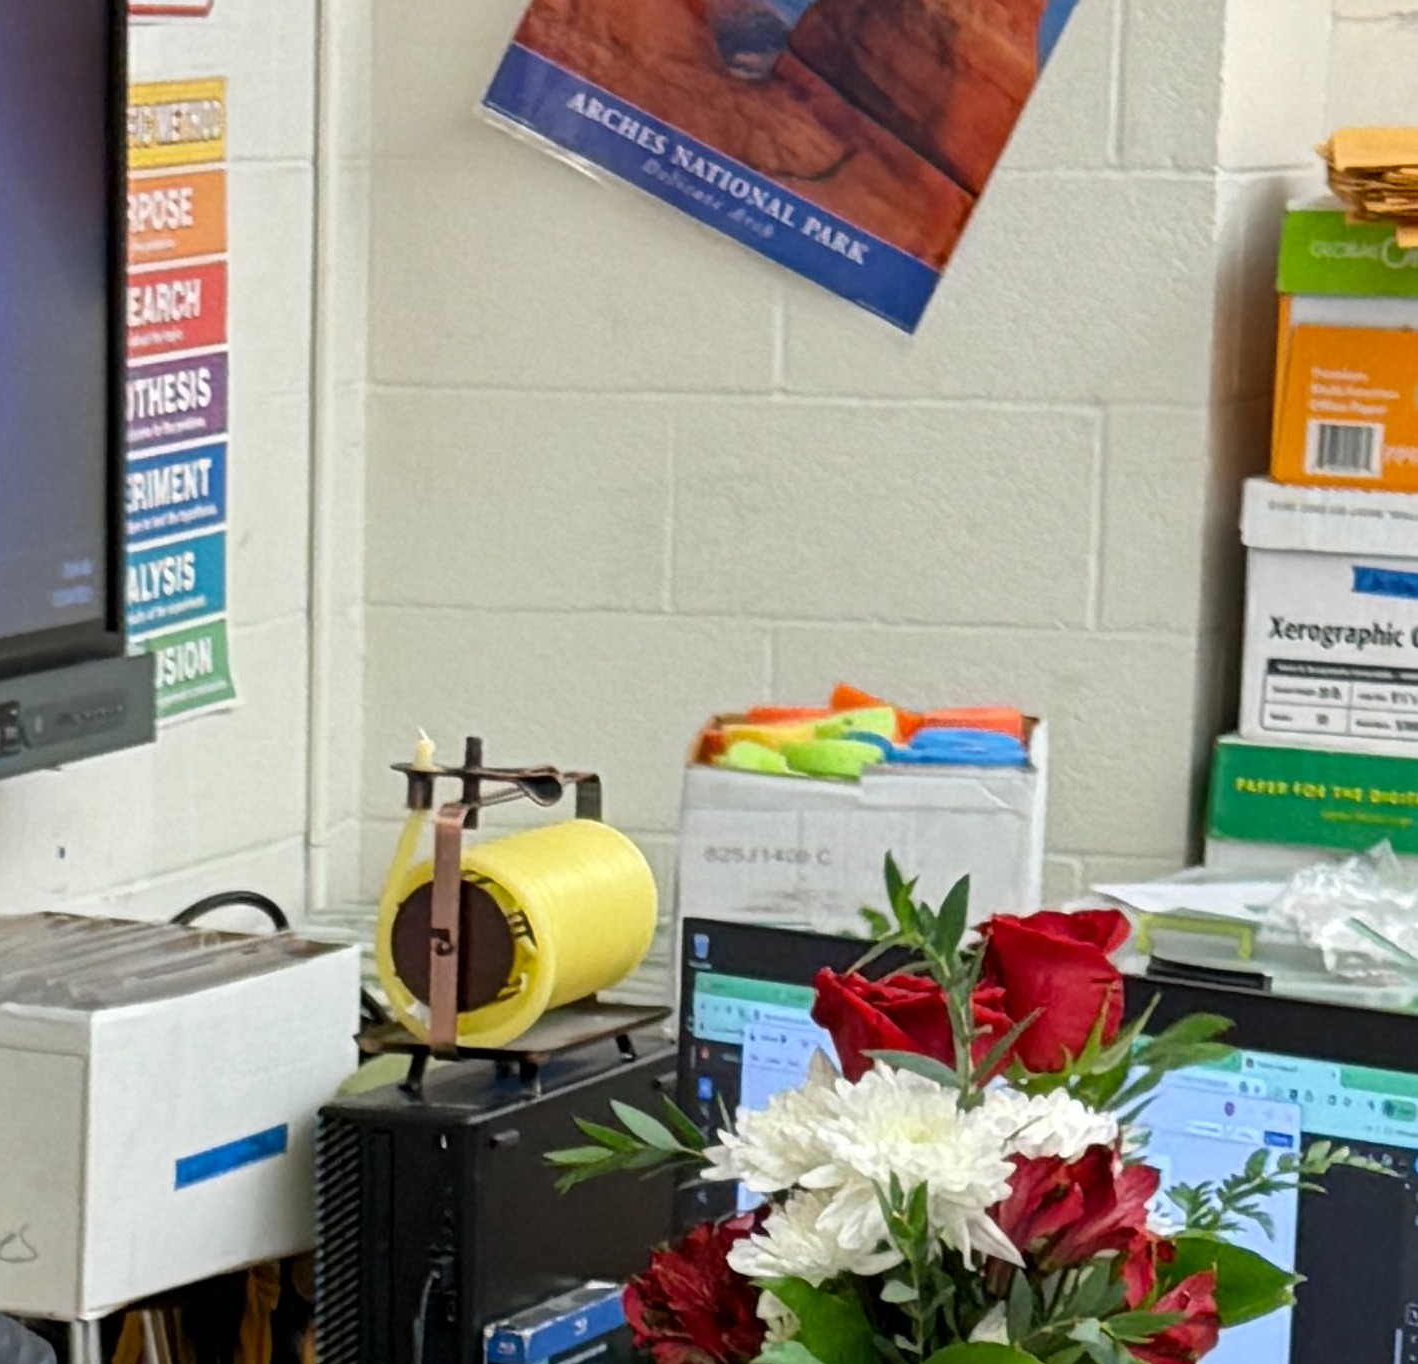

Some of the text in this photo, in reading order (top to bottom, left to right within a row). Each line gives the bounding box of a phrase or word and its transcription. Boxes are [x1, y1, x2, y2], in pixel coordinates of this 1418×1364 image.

[566, 92, 870, 266] ARCHES NATIONAL PARK
[1269, 615, 1405, 652] Xerographic
[1235, 776, 1289, 796] PAPER
